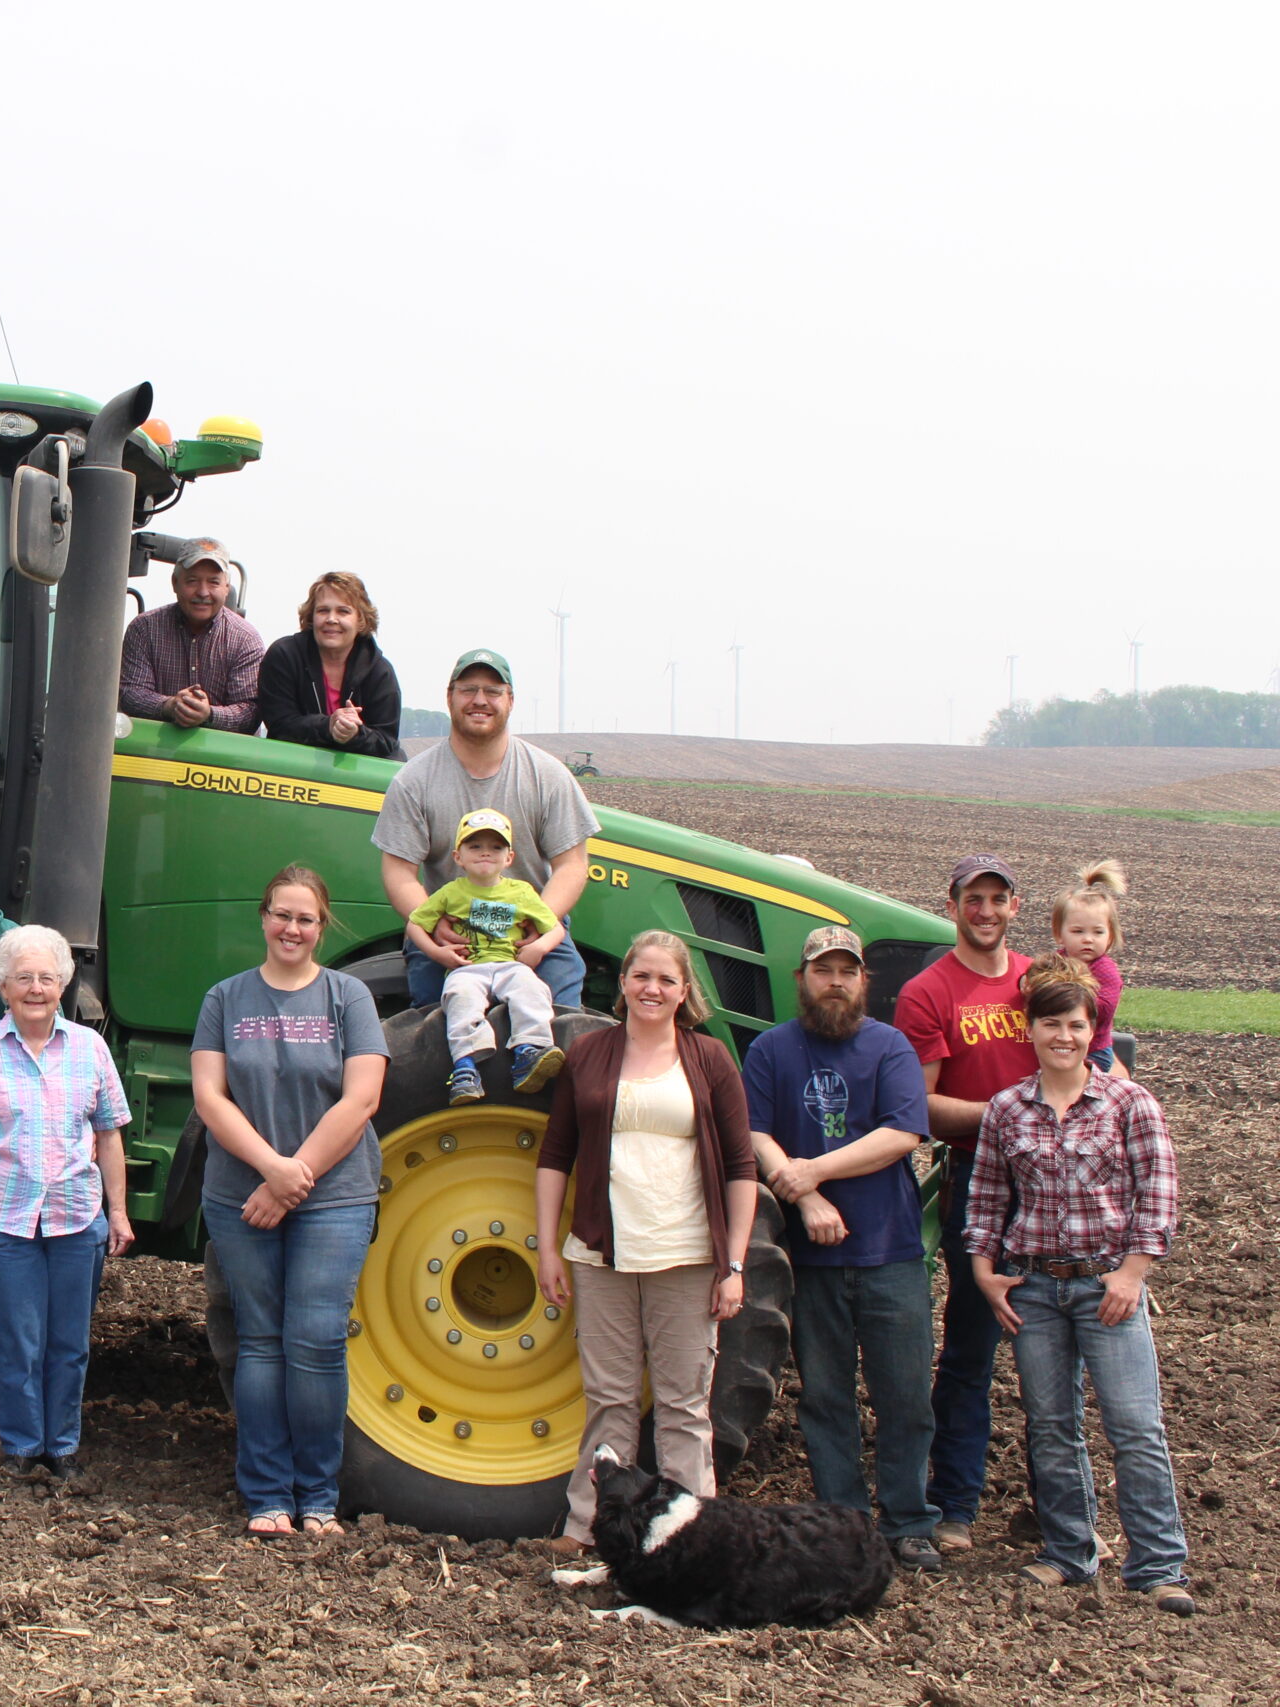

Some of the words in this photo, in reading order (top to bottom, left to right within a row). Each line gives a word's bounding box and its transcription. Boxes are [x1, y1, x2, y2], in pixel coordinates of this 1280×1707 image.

[176, 767, 241, 792] JOHN
[245, 776, 321, 803] DEERE
[960, 1010, 1027, 1046] CYCLO
[824, 1112, 847, 1138] 33
